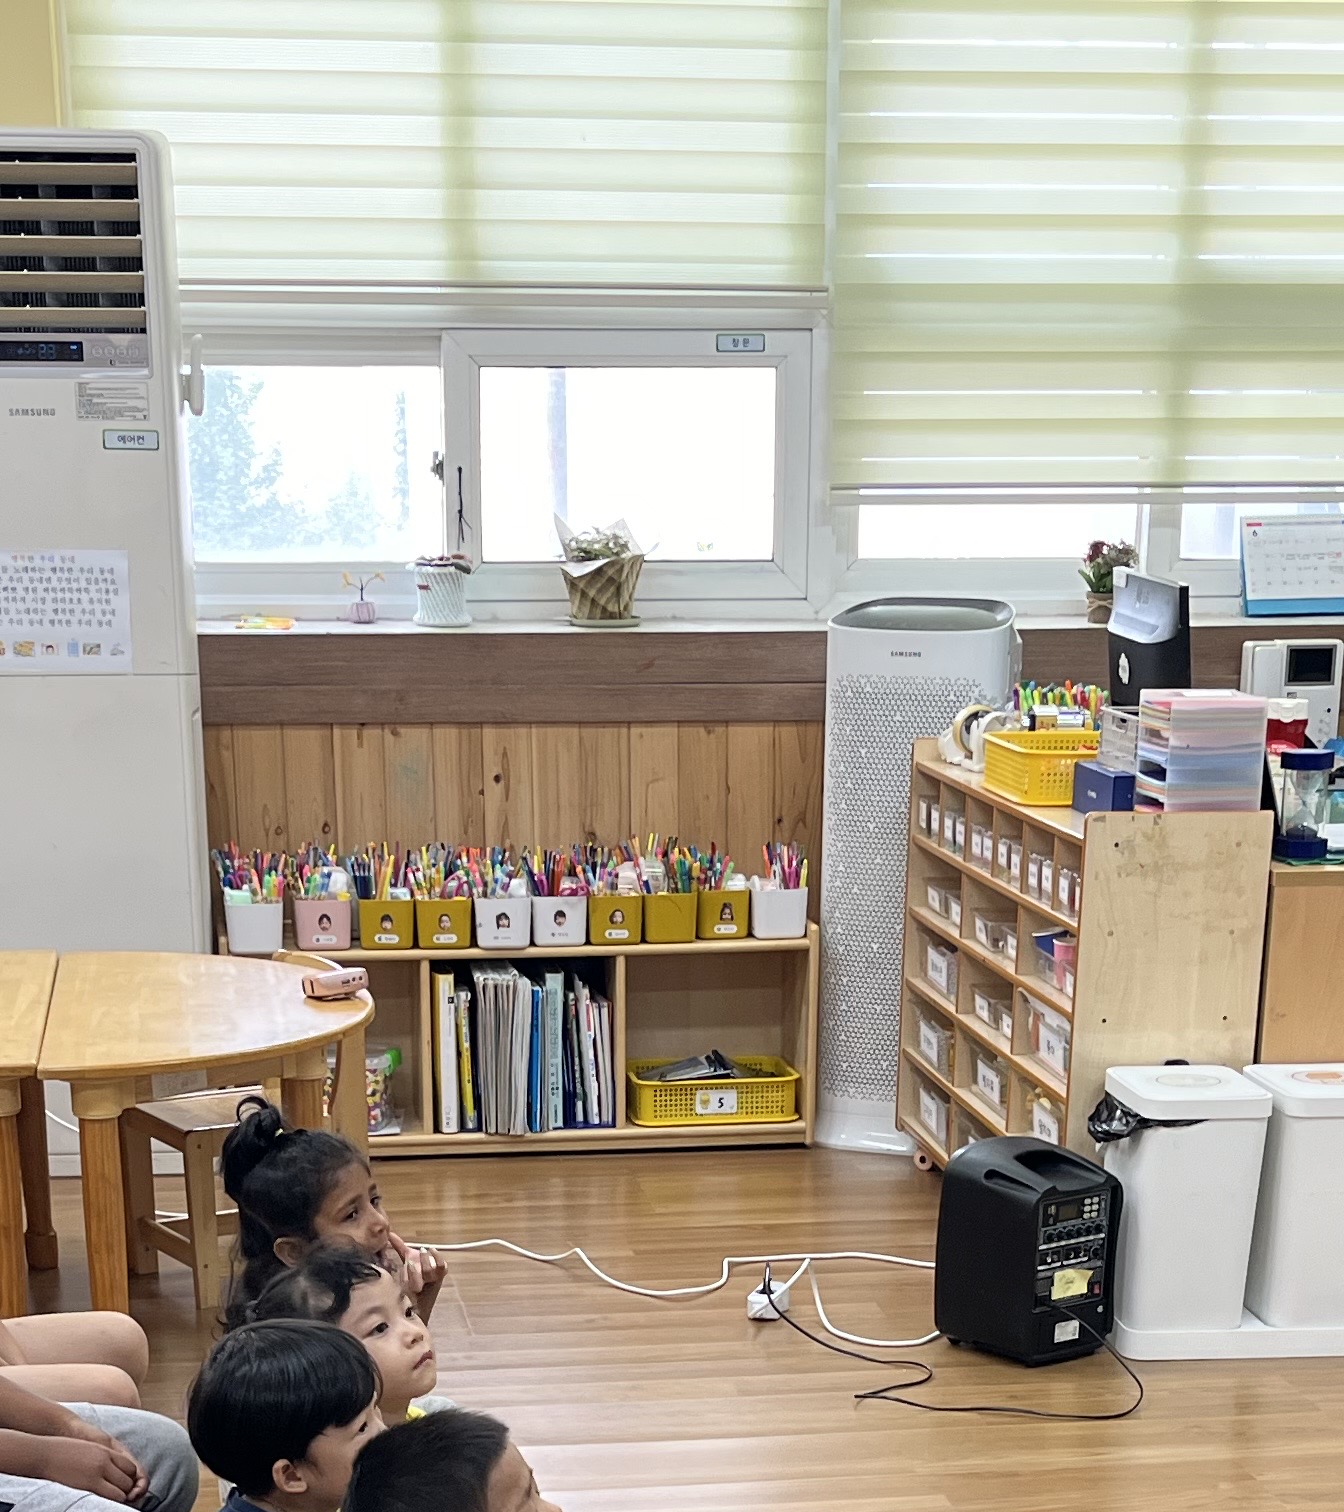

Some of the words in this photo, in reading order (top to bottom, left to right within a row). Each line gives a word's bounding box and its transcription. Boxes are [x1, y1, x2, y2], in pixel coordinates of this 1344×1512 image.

[8, 408, 56, 416] SAMSUNG
[116, 434, 145, 446] 에어컨
[717, 1097, 724, 1109] 5
